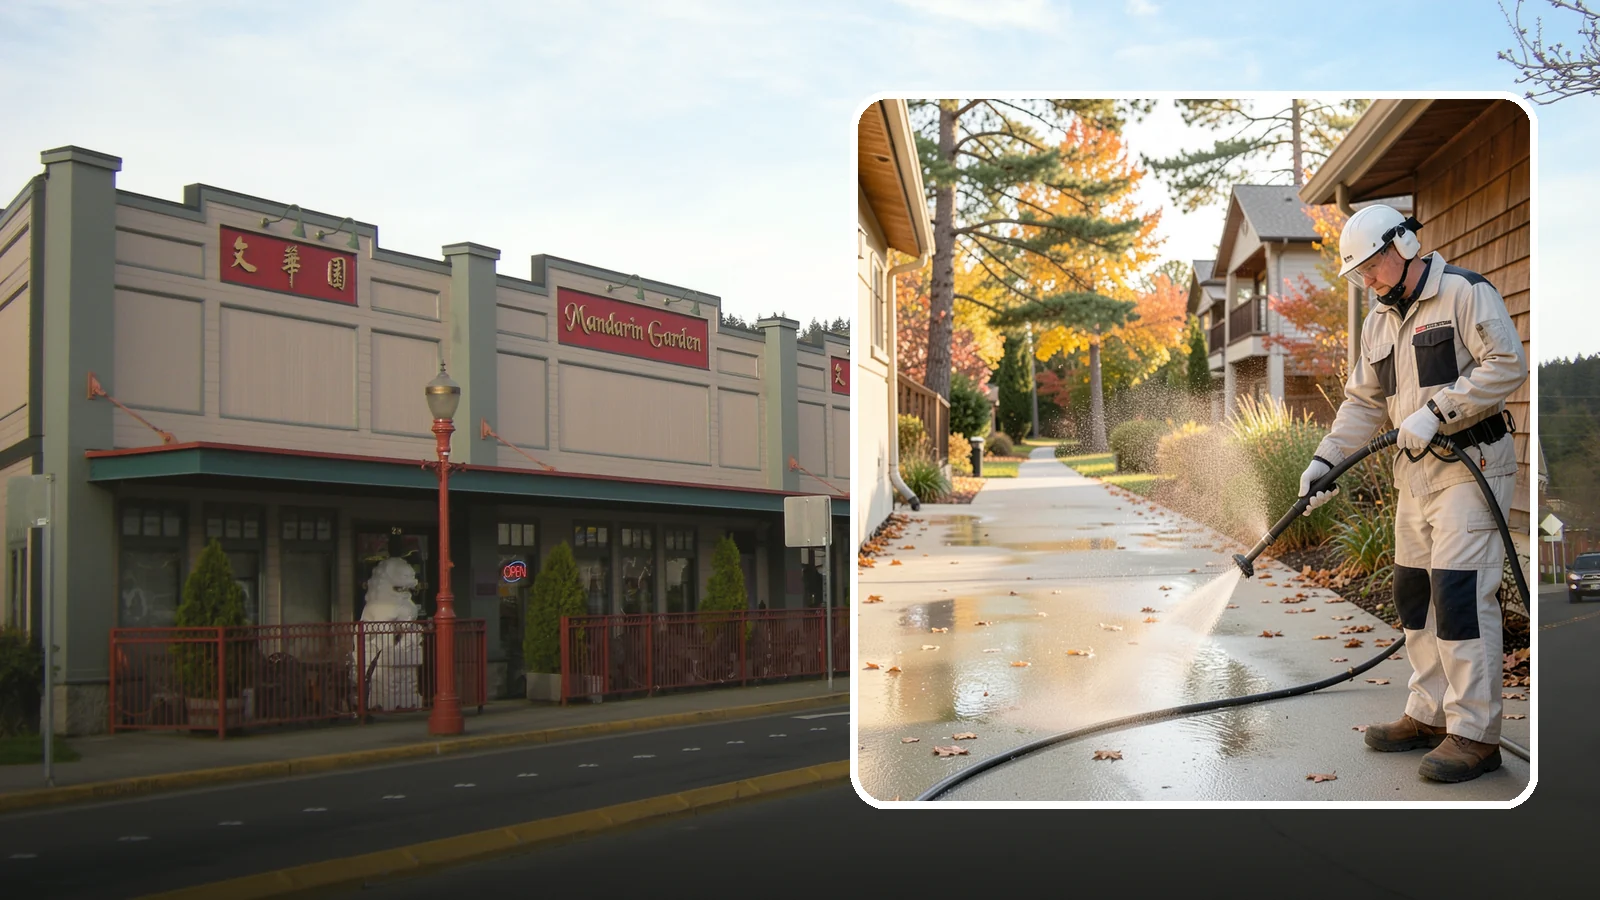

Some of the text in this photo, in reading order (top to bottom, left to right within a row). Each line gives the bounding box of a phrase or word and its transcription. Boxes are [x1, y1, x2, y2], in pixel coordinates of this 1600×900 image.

[230, 235, 346, 291] 文華園
[564, 302, 702, 352] Mandarin Garden
[503, 565, 527, 578] OPEN
